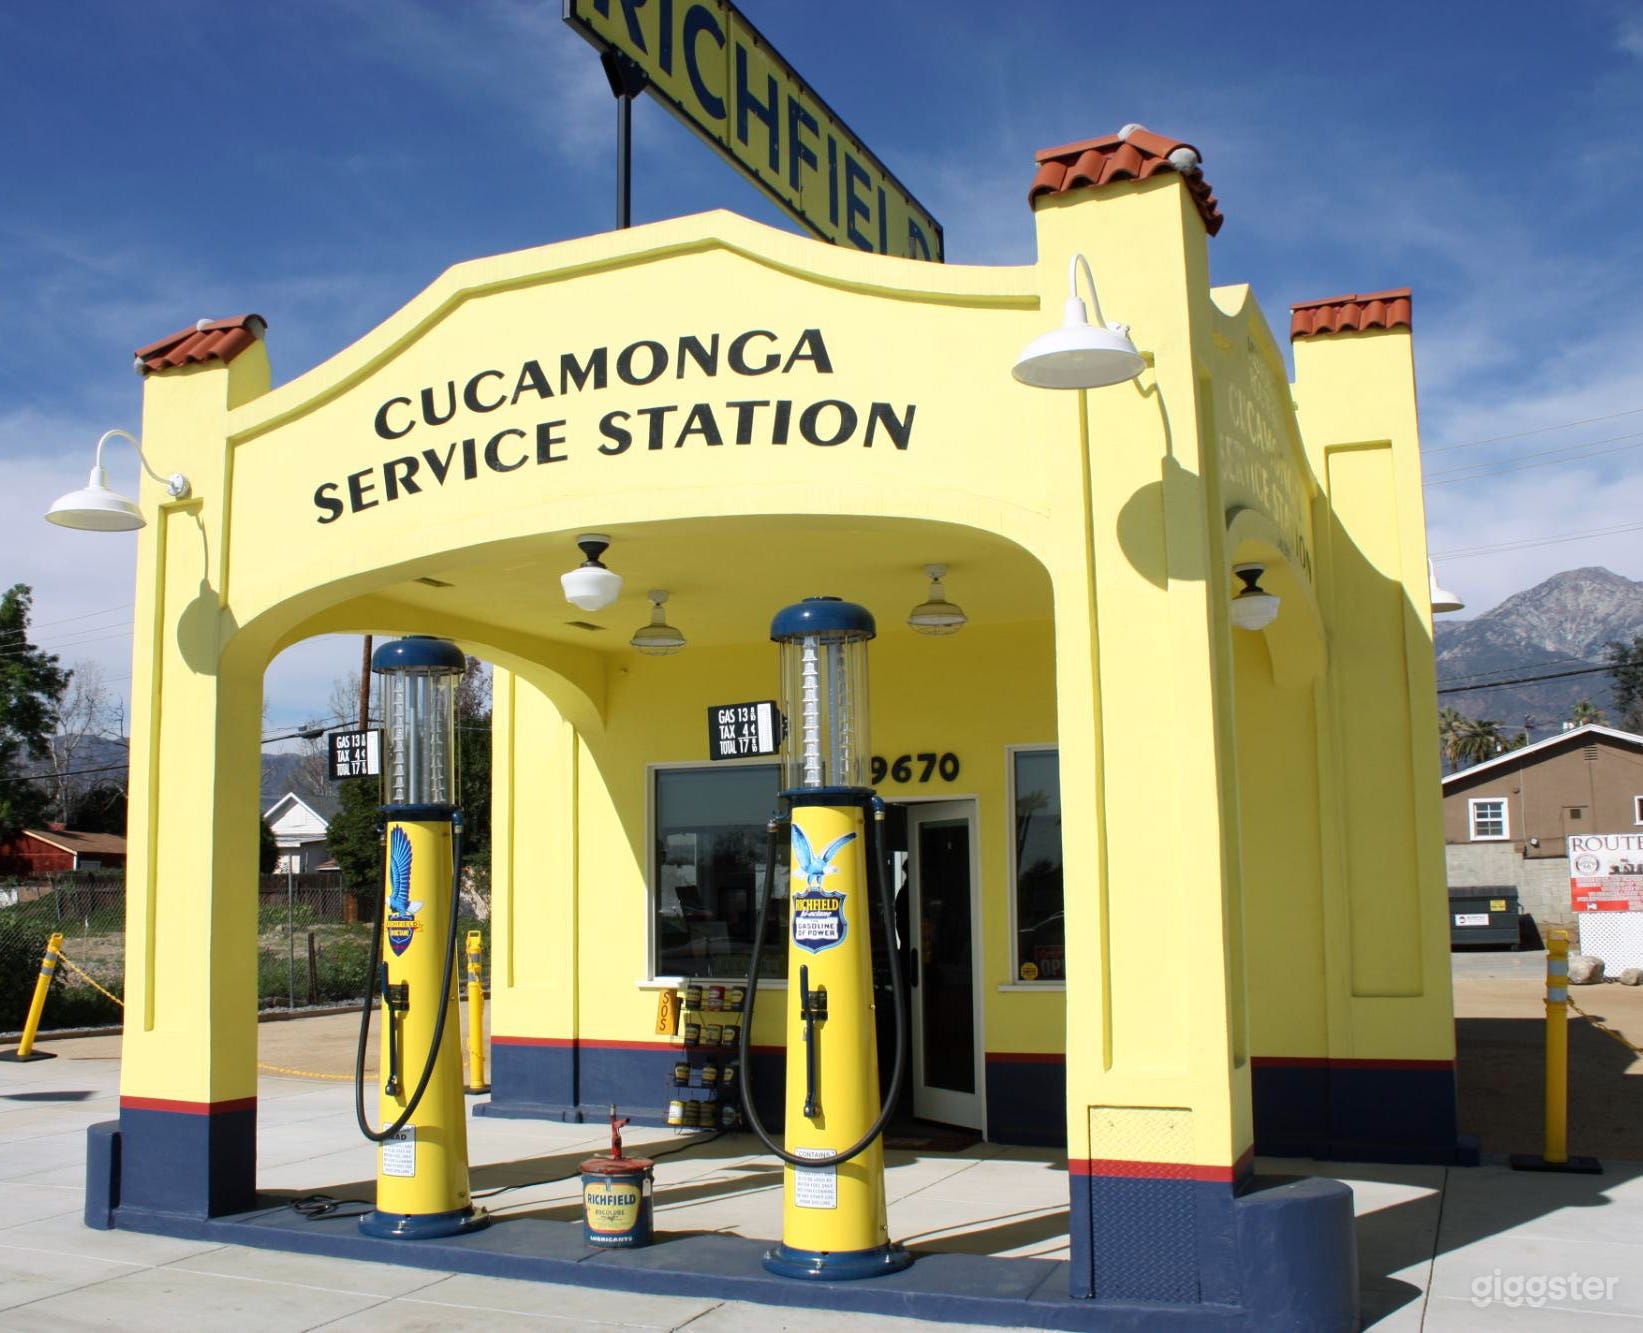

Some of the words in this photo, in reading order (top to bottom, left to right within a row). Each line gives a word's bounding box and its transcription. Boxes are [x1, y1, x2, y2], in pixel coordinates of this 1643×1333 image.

[373, 328, 835, 440] CUCAMONGA
[313, 419, 569, 525] SERVICE
[597, 399, 917, 457] STATION
[718, 709, 735, 724] GAS
[738, 708, 748, 722] 13
[719, 724, 736, 740] TAX
[336, 736, 350, 748] GAS
[352, 735, 360, 747] 13
[720, 740, 737, 755] TOTAL
[738, 738, 749, 753] 17
[336, 749, 350, 763] TAX
[352, 762, 360, 775] 17
[871, 752, 960, 785] 9670
[1571, 836, 1643, 852] ROUTE
[587, 1193, 636, 1206] RICHFIELD
